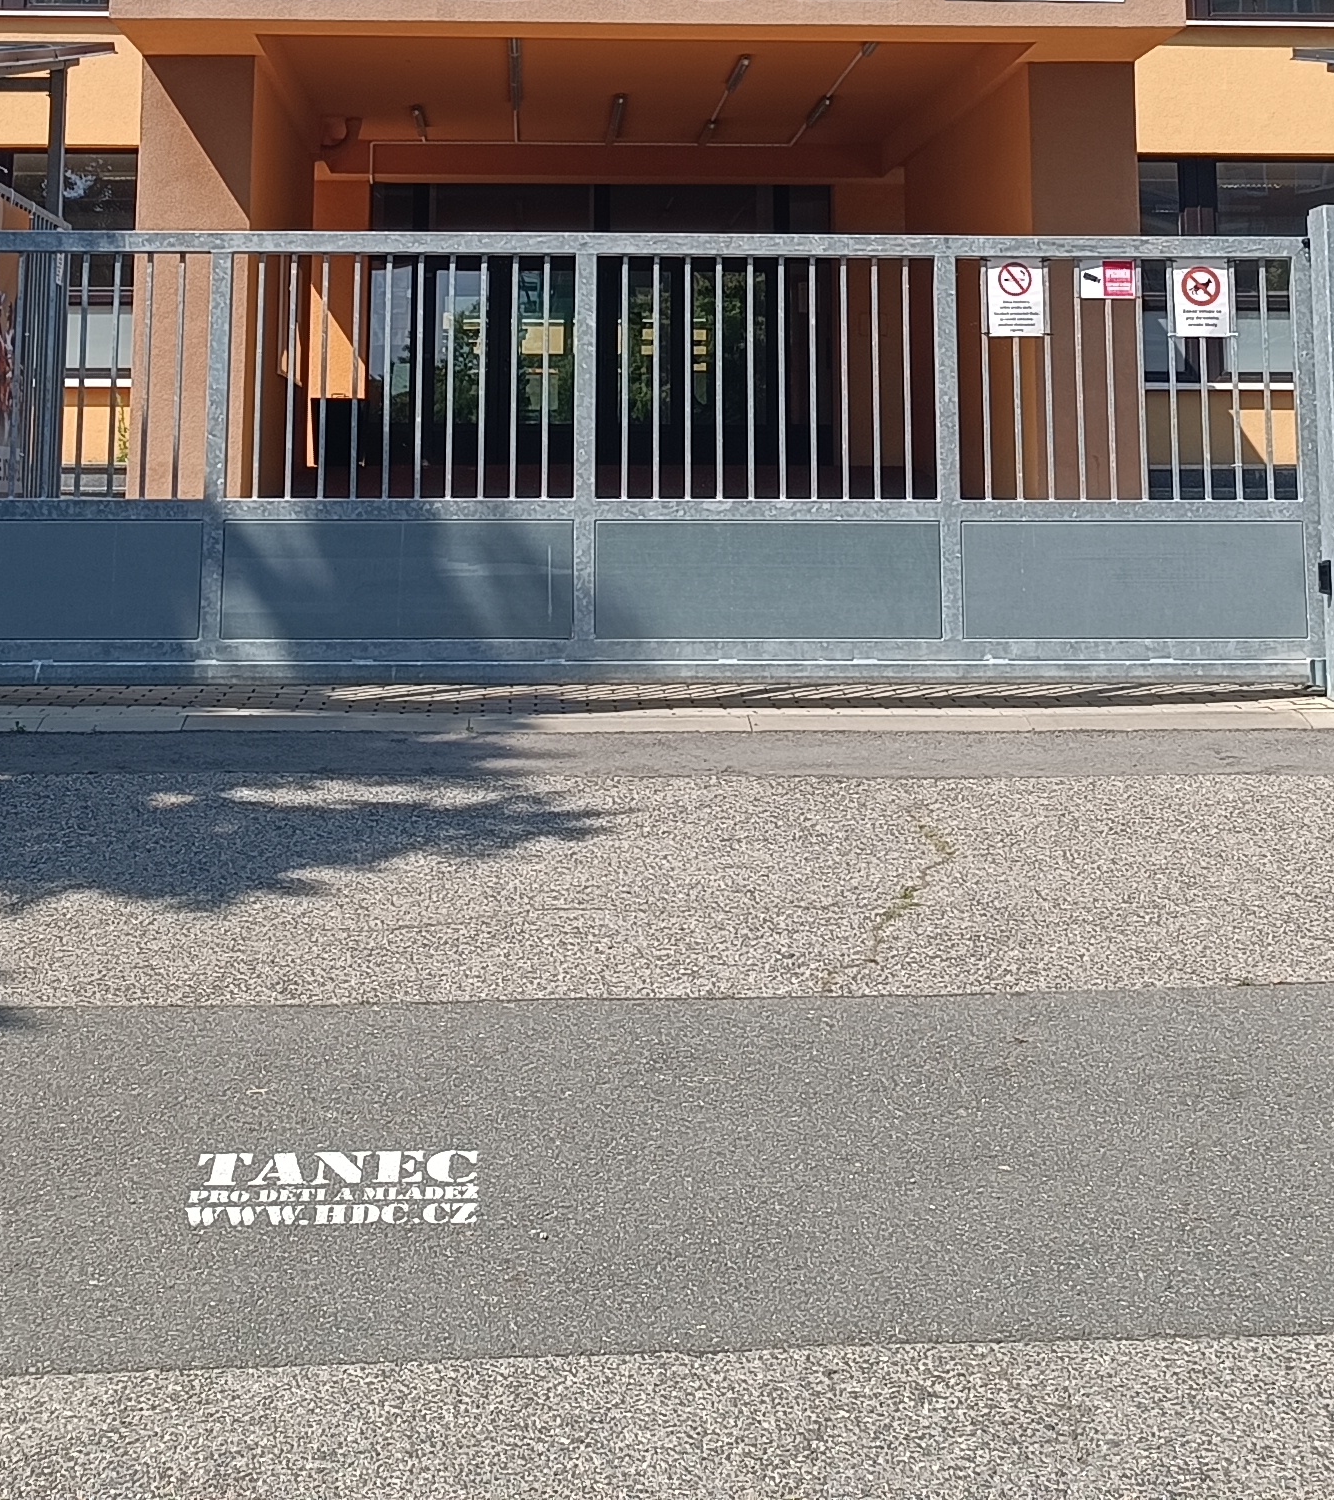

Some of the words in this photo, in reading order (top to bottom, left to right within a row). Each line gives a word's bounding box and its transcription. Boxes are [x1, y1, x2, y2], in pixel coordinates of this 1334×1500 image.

[198, 1150, 479, 1186] TANEC
[188, 1189, 250, 1203] PRO
[333, 1187, 354, 1201] A
[185, 1201, 479, 1227] WWW.HDC.CZ
